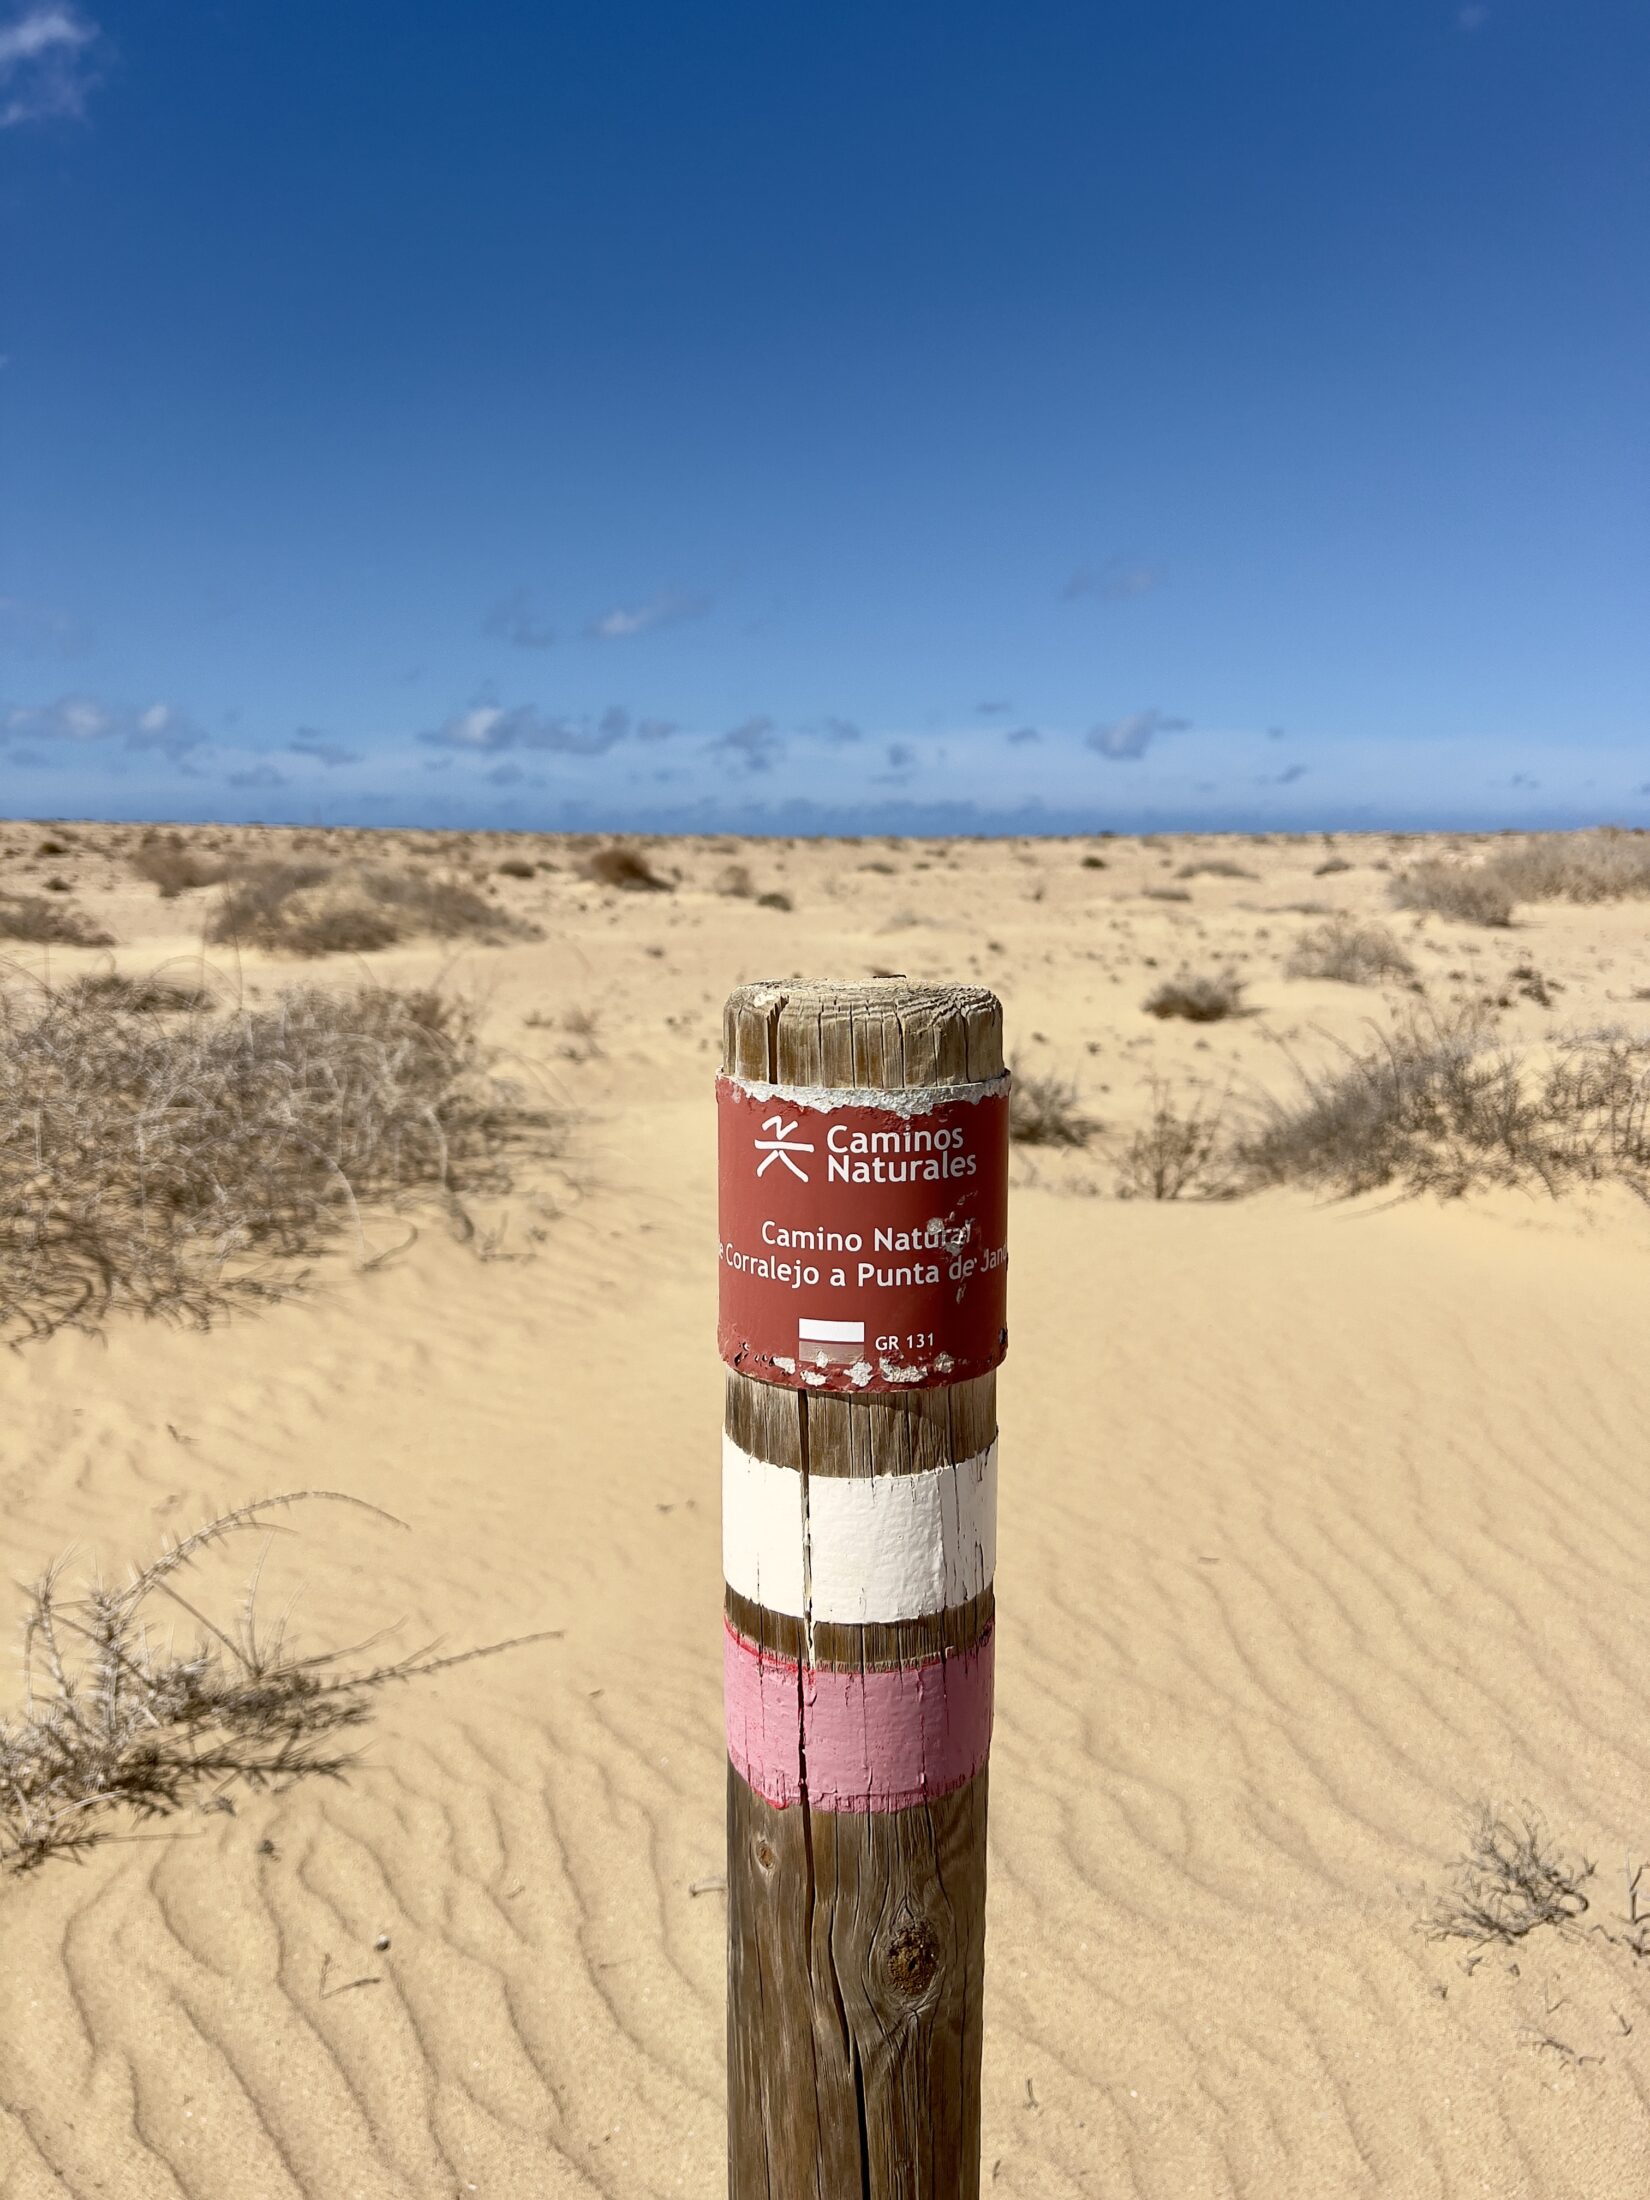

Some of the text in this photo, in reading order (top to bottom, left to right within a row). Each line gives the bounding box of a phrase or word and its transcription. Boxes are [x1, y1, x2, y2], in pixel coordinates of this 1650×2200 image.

[826, 1125, 964, 1154] Caminos
[827, 1151, 977, 1183] Naturales
[761, 1220, 863, 1252] Camino
[725, 1242, 820, 1289] Corralejo
[830, 1267, 846, 1287] a
[858, 1263, 940, 1288] Punta
[948, 1255, 976, 1280] de
[875, 1332, 935, 1351] GR 131
